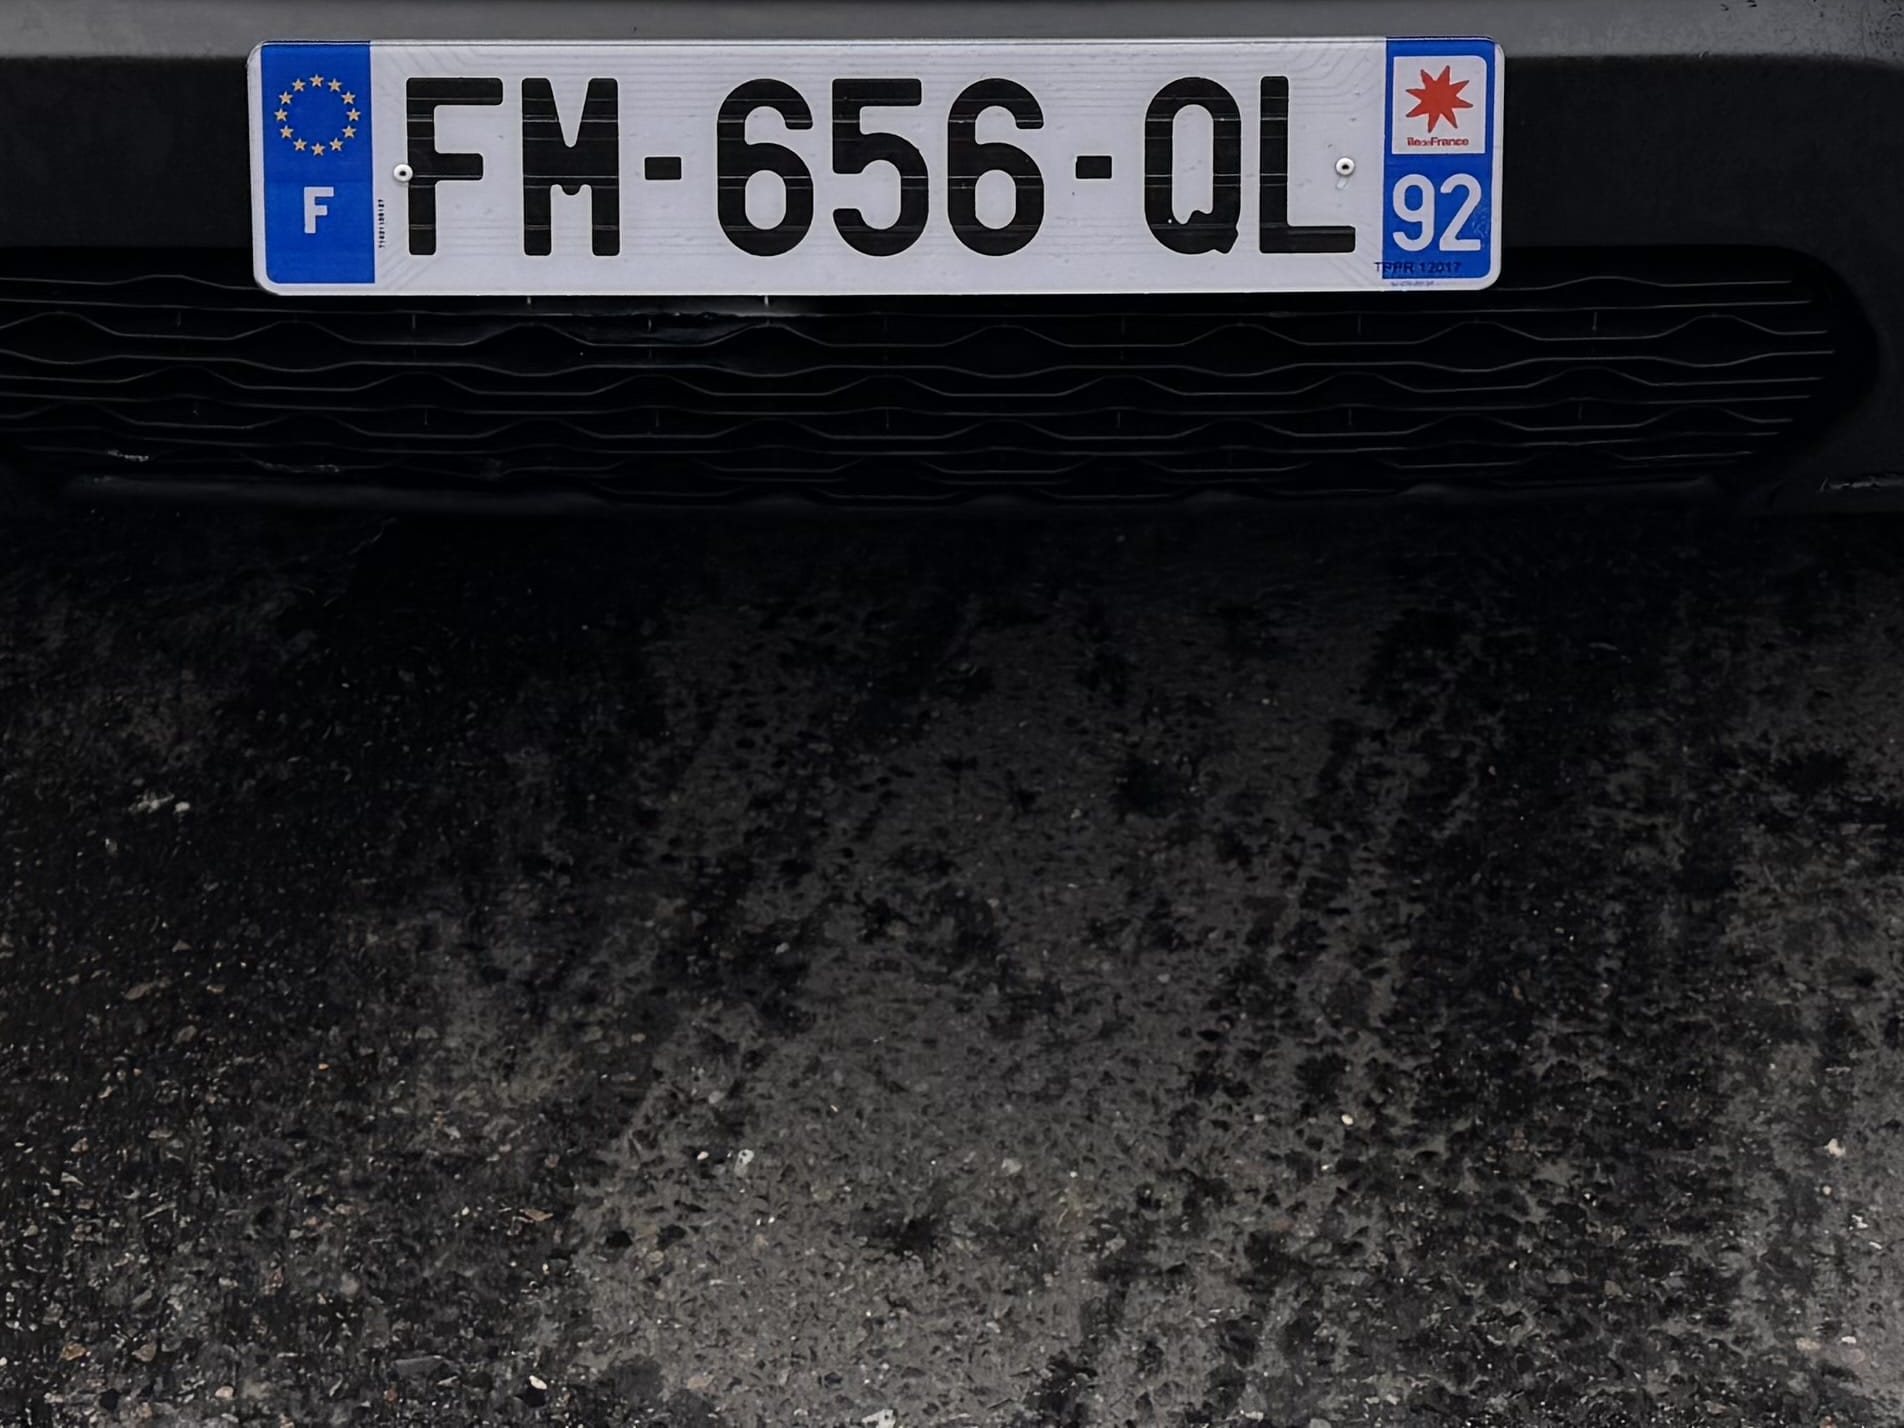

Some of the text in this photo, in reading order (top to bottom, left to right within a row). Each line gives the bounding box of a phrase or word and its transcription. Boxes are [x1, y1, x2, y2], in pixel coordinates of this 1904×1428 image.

[406, 75, 1356, 259] FM-656-QL
[303, 186, 335, 234] F
[1392, 174, 1481, 252] 92
